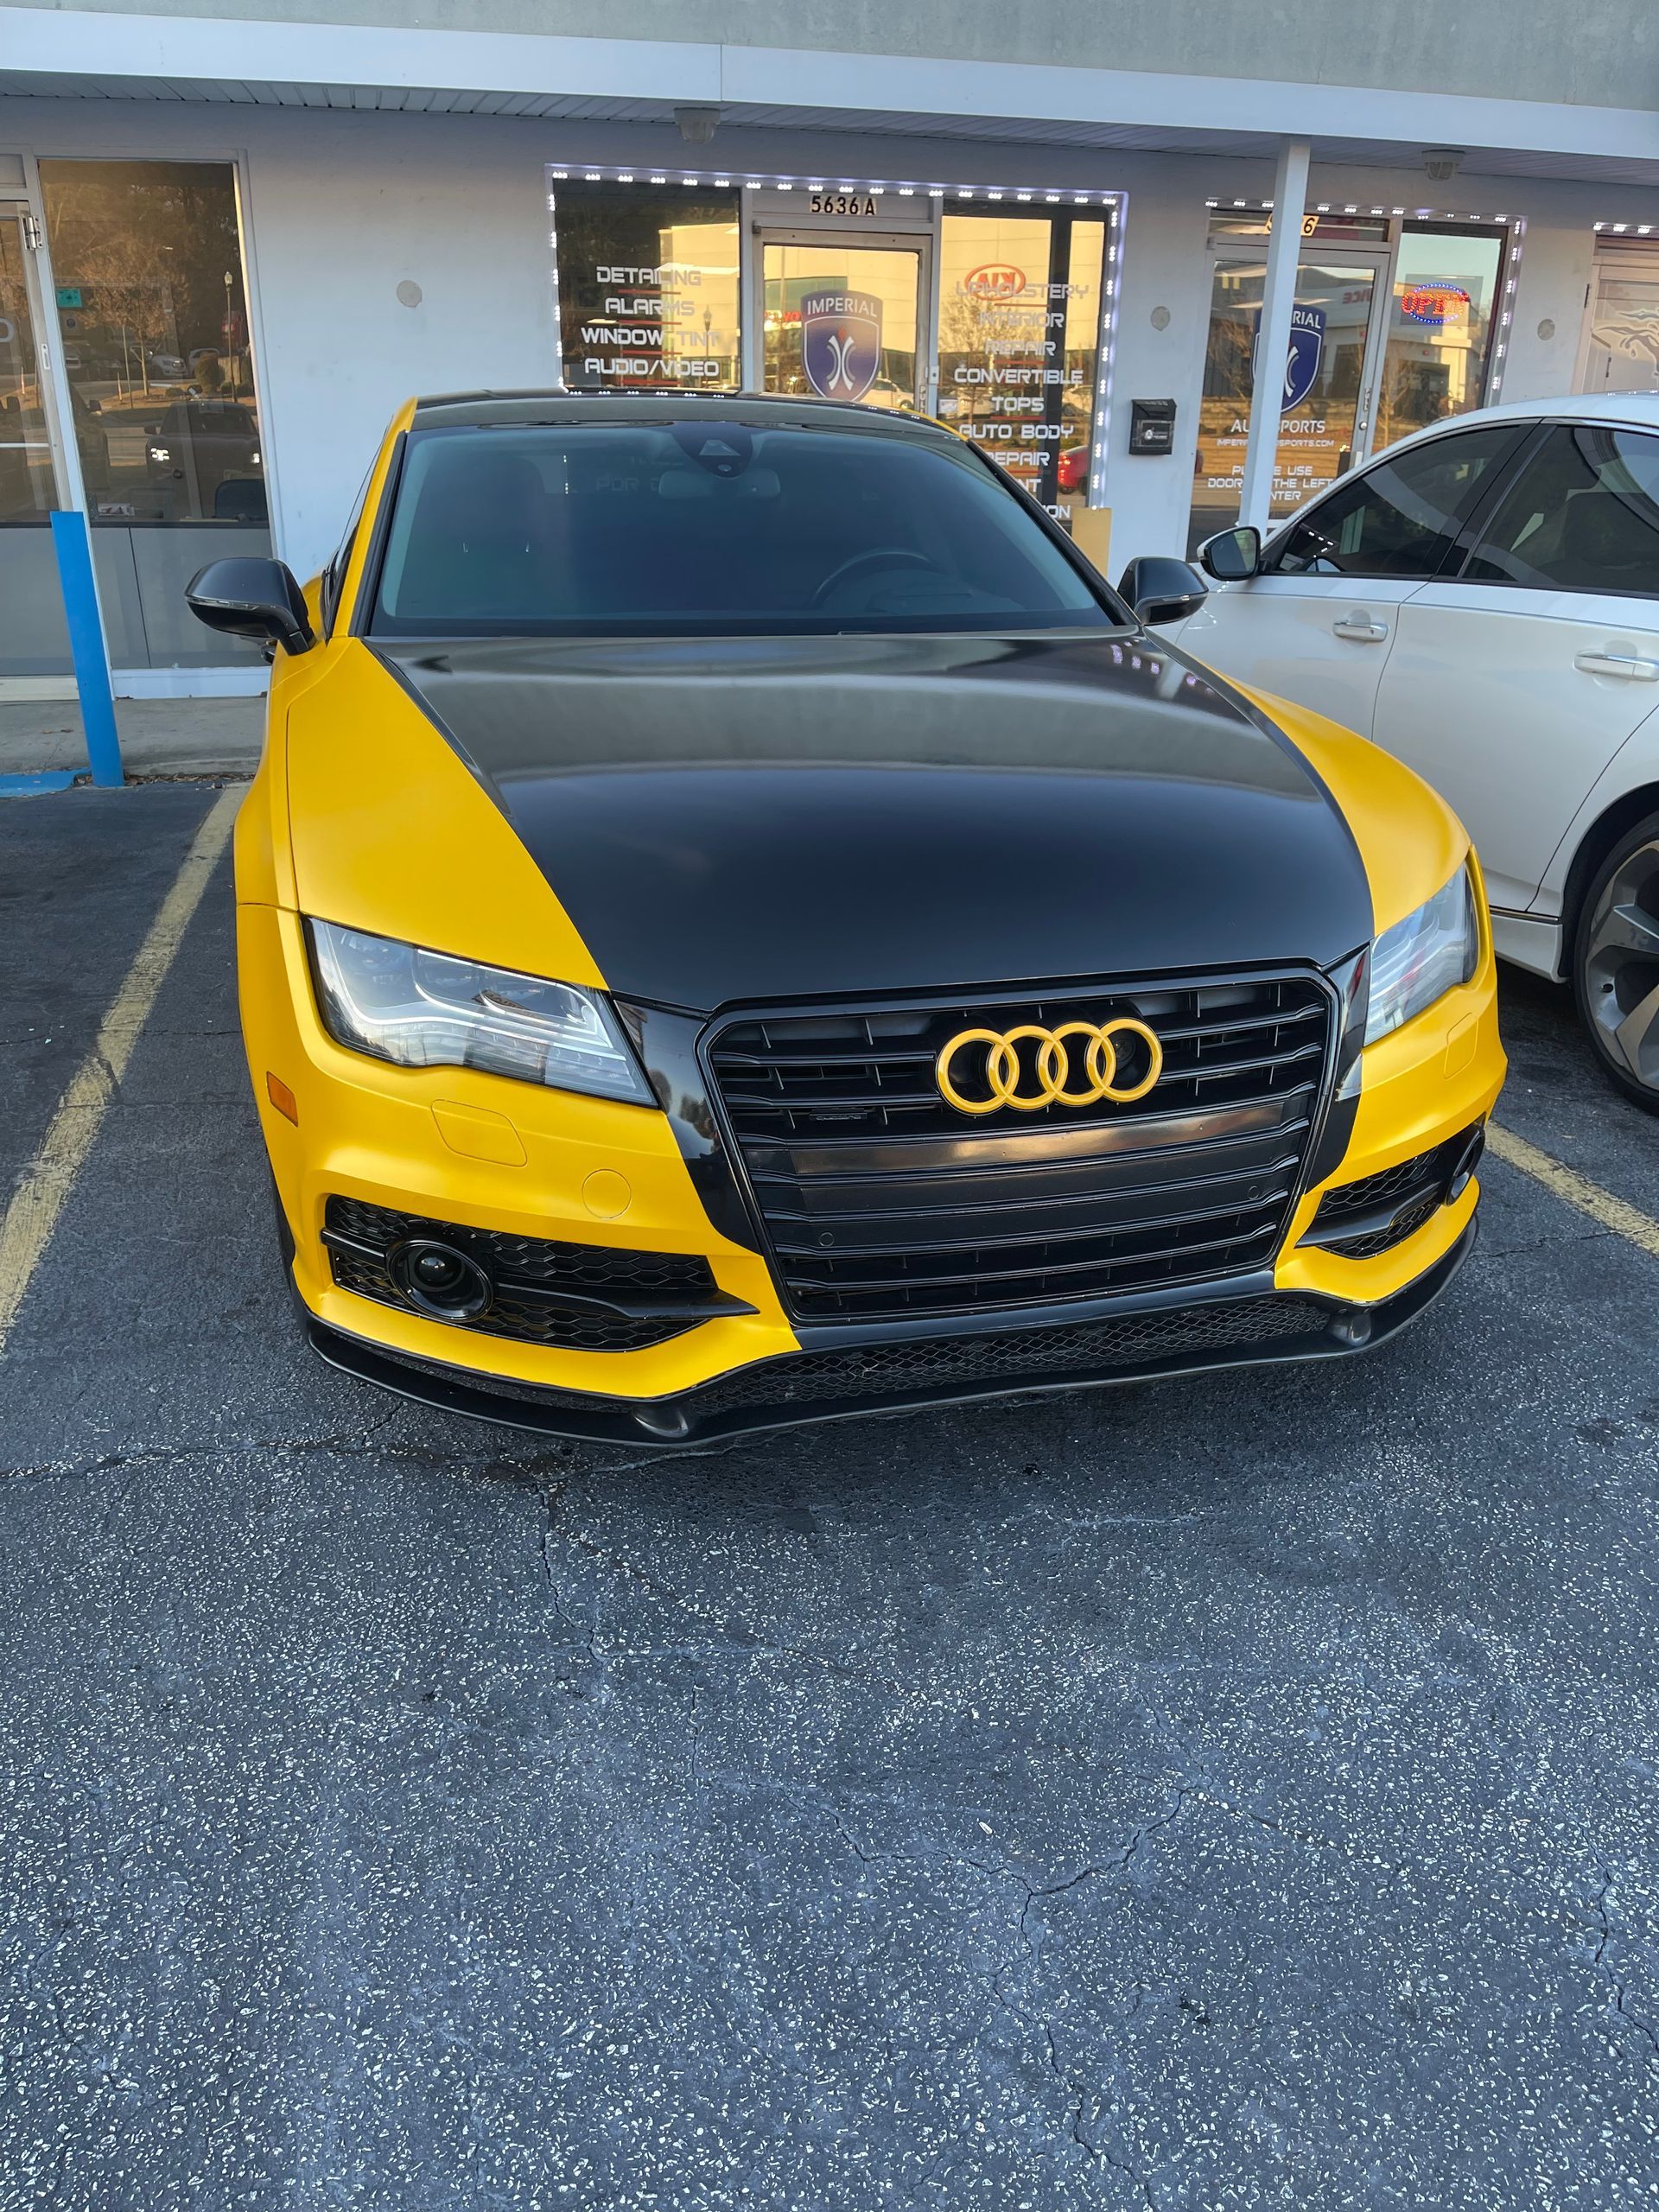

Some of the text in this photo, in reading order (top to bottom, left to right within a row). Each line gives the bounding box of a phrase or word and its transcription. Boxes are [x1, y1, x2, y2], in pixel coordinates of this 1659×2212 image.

[596, 266, 702, 286] DETAILING
[957, 282, 1089, 299] UPHOLSTERY
[605, 297, 695, 316] ALARMS
[807, 297, 877, 318] IMPERIAL
[1402, 291, 1469, 317] OPEN
[979, 311, 1065, 327] INTERIOR
[581, 327, 722, 346] WINDOW TINT
[985, 340, 1056, 356] REPAIR
[584, 358, 719, 377] AUDIO/VIDEO
[954, 368, 1084, 384] CONVERTIBLE
[992, 397, 1044, 411] TOPS
[959, 424, 1074, 439] AUTO BODY
[1230, 419, 1325, 433] AUPORTS
[1287, 466, 1313, 475] USE
[1274, 479, 1297, 487] THE
[1303, 479, 1333, 487] LEFT
[1271, 491, 1301, 500] NTER
